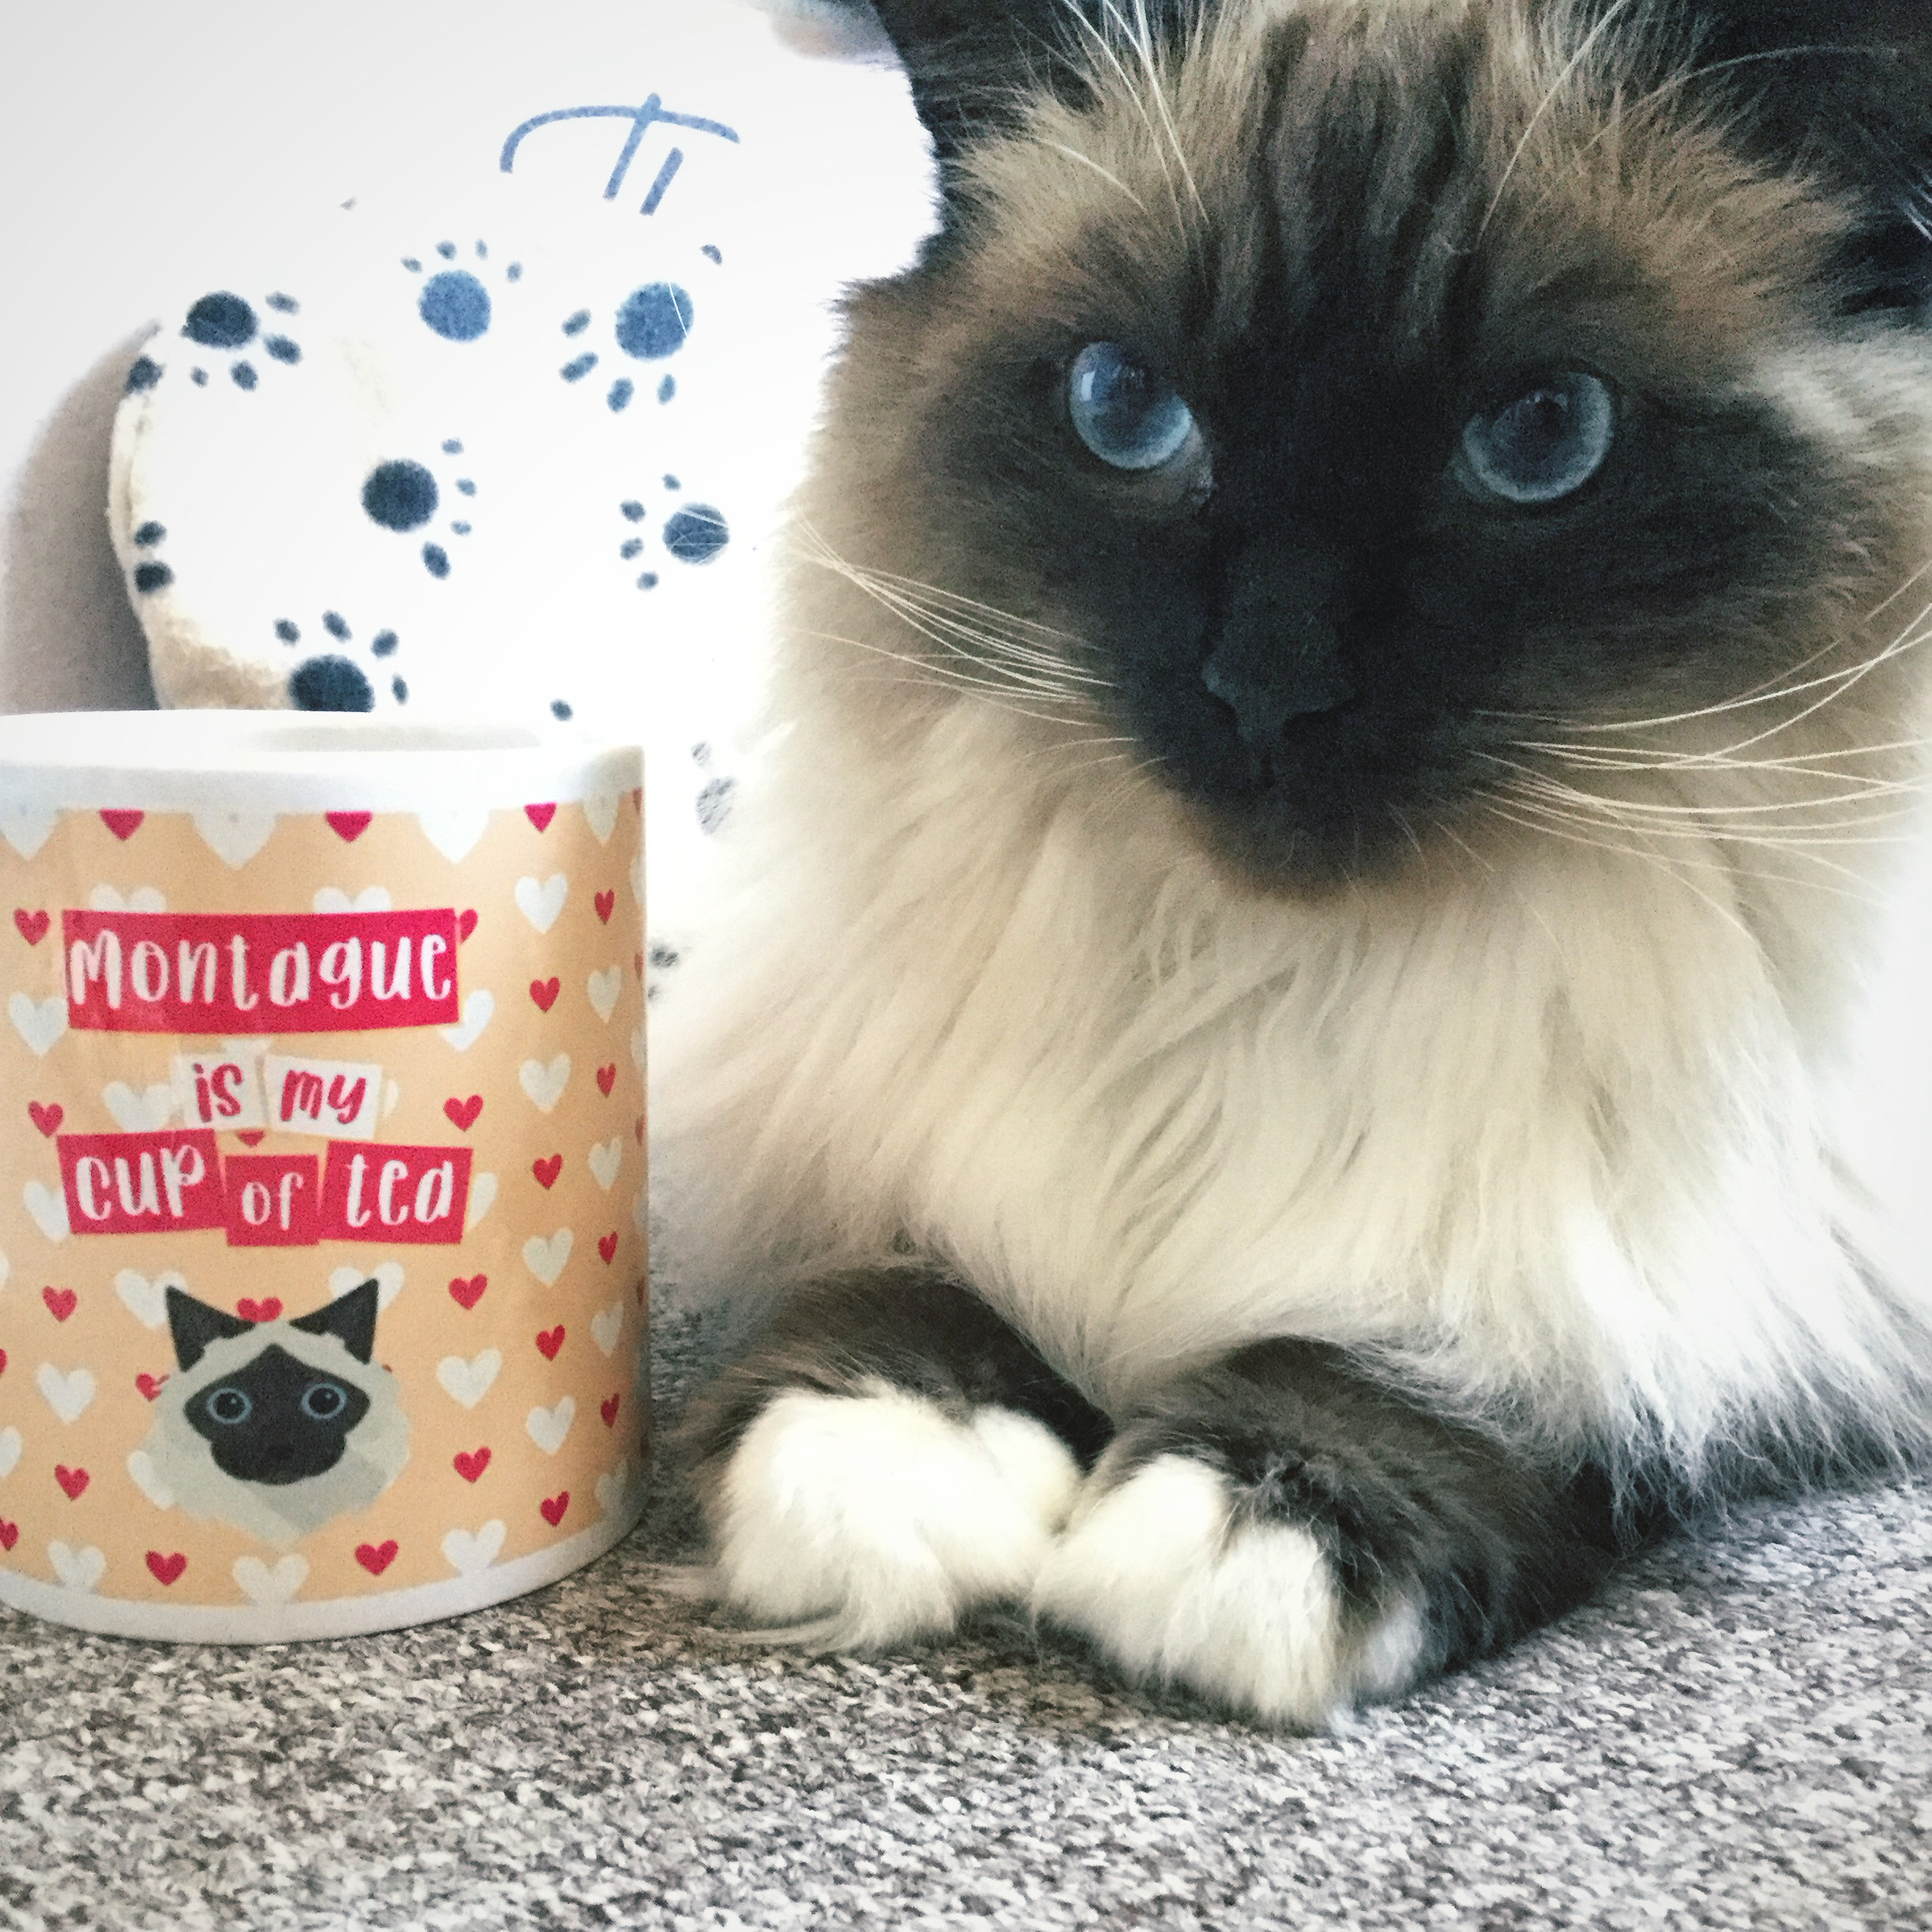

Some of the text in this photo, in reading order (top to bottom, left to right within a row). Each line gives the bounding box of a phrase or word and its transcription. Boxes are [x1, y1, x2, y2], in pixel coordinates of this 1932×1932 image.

[68, 928, 452, 1011] Montague
[193, 1063, 368, 1124] is my
[75, 1143, 455, 1231] cup of tea
